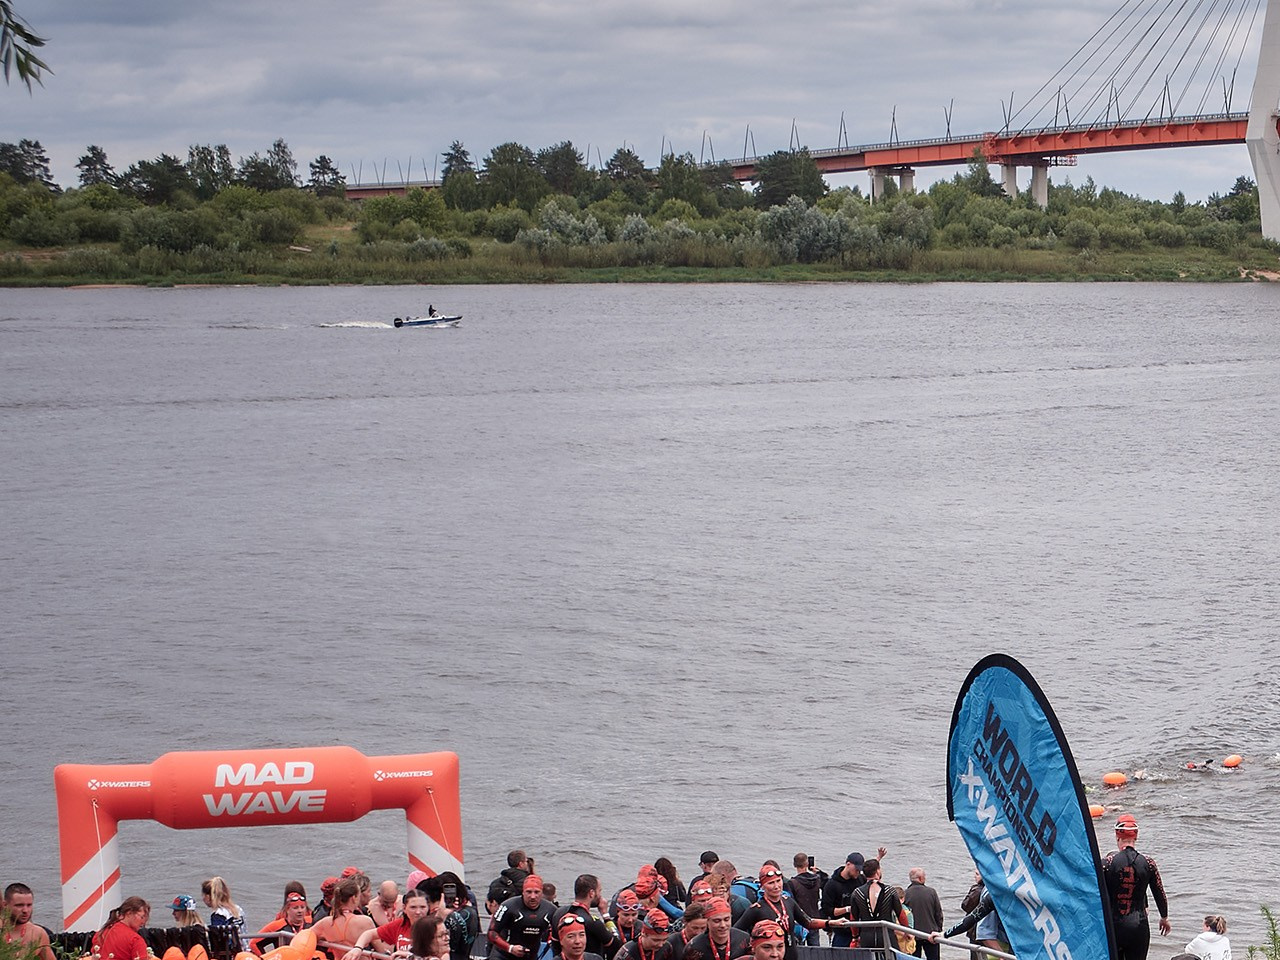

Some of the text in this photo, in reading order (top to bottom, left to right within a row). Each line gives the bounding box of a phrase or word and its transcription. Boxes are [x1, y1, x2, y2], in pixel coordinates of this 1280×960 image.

[202, 789, 327, 817] WAVE
[214, 761, 314, 788] MAD
[973, 738, 1045, 874] CHAMPIONSHIP
[983, 700, 1057, 857] WORLD
